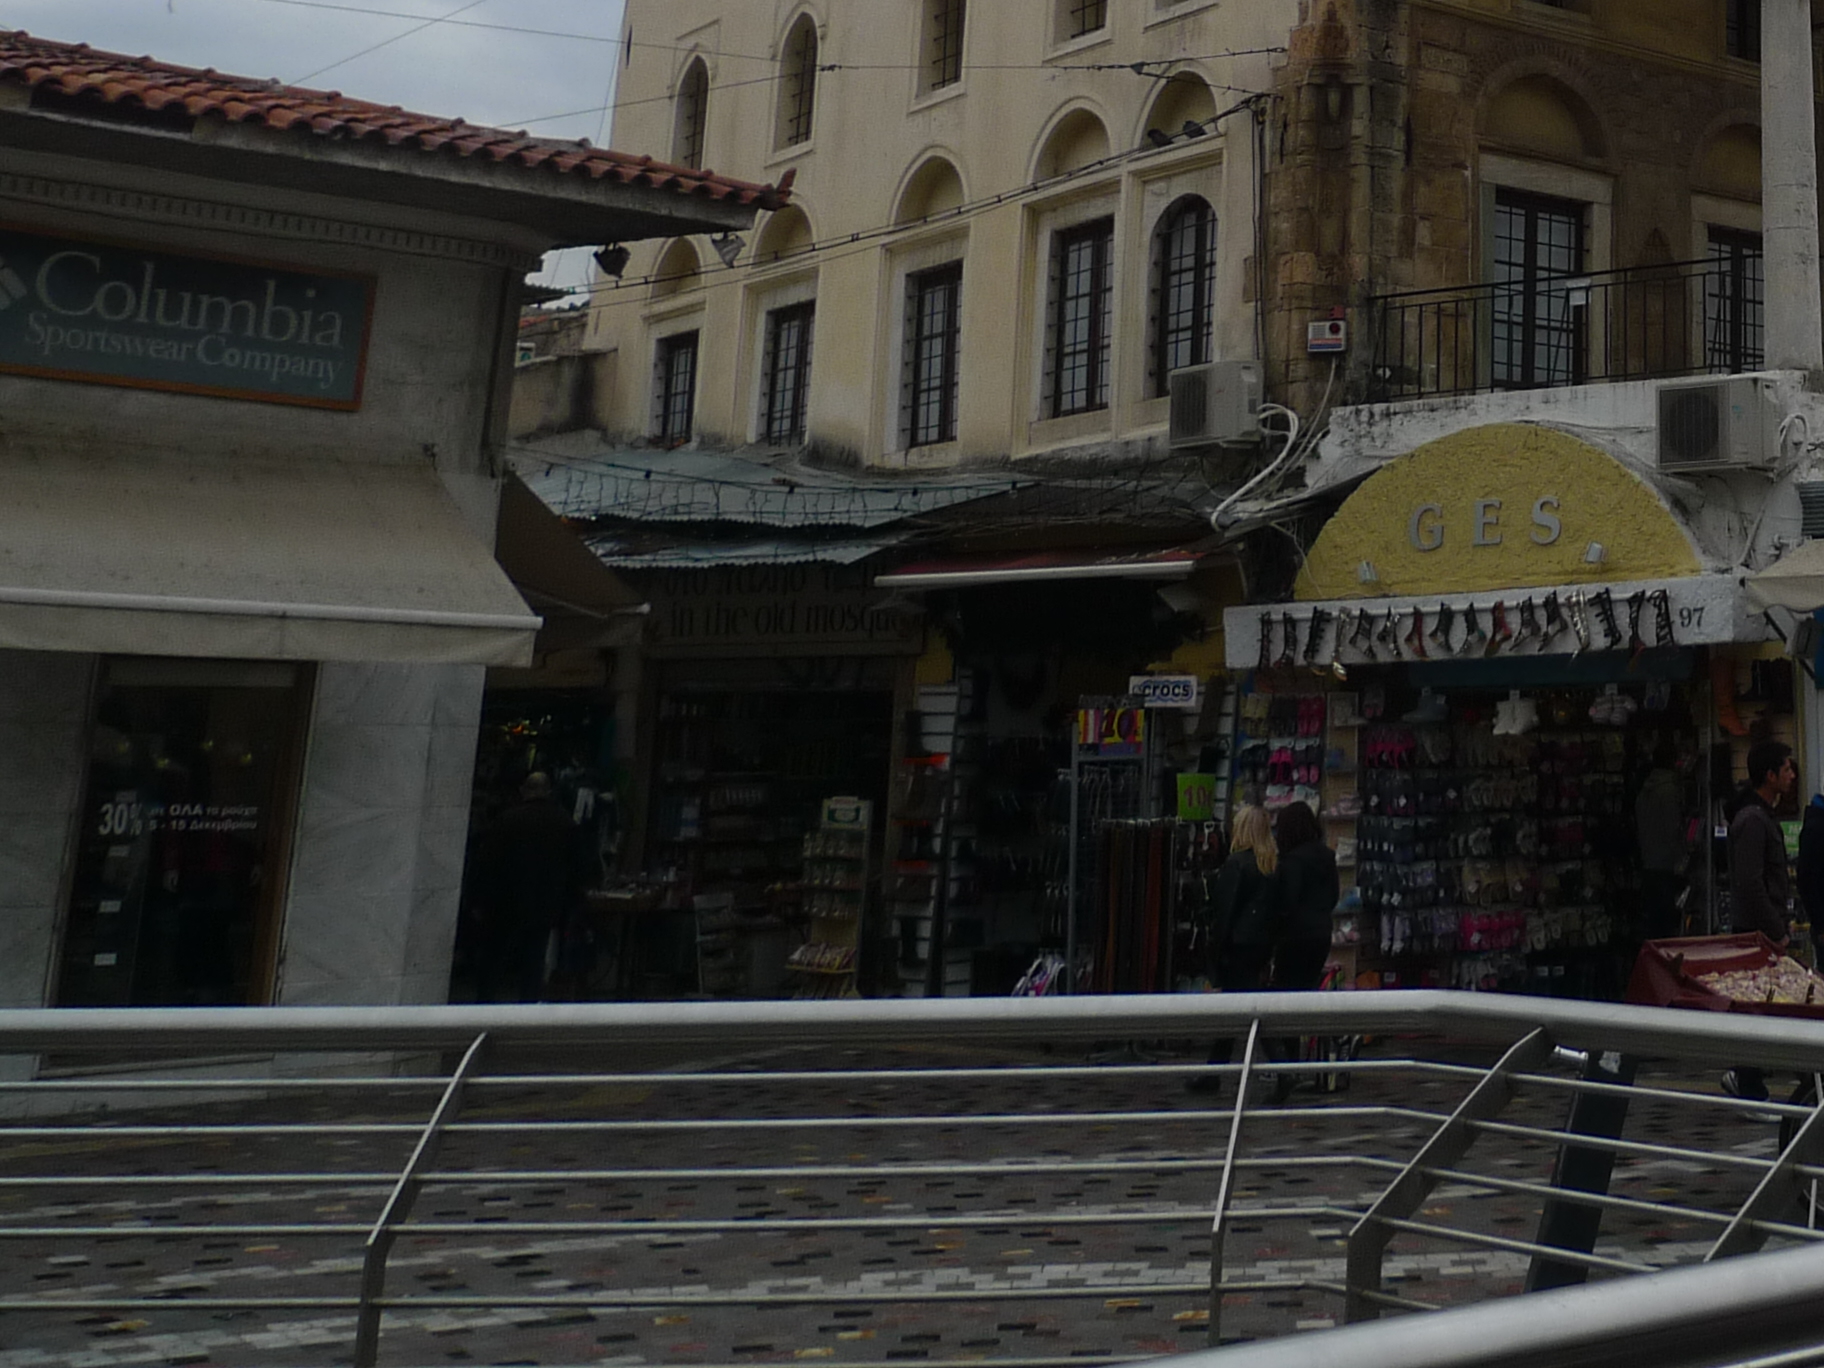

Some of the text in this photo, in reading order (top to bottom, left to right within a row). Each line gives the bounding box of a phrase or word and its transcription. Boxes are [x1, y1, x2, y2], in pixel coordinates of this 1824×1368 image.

[36, 250, 344, 349] Columbia
[25, 311, 344, 389] Sportswear Company
[670, 601, 694, 636] in
[704, 601, 748, 635] the
[755, 599, 796, 635] old
[1679, 606, 1705, 628] 97
[1143, 684, 1191, 697] crocs
[98, 802, 143, 836] 30%
